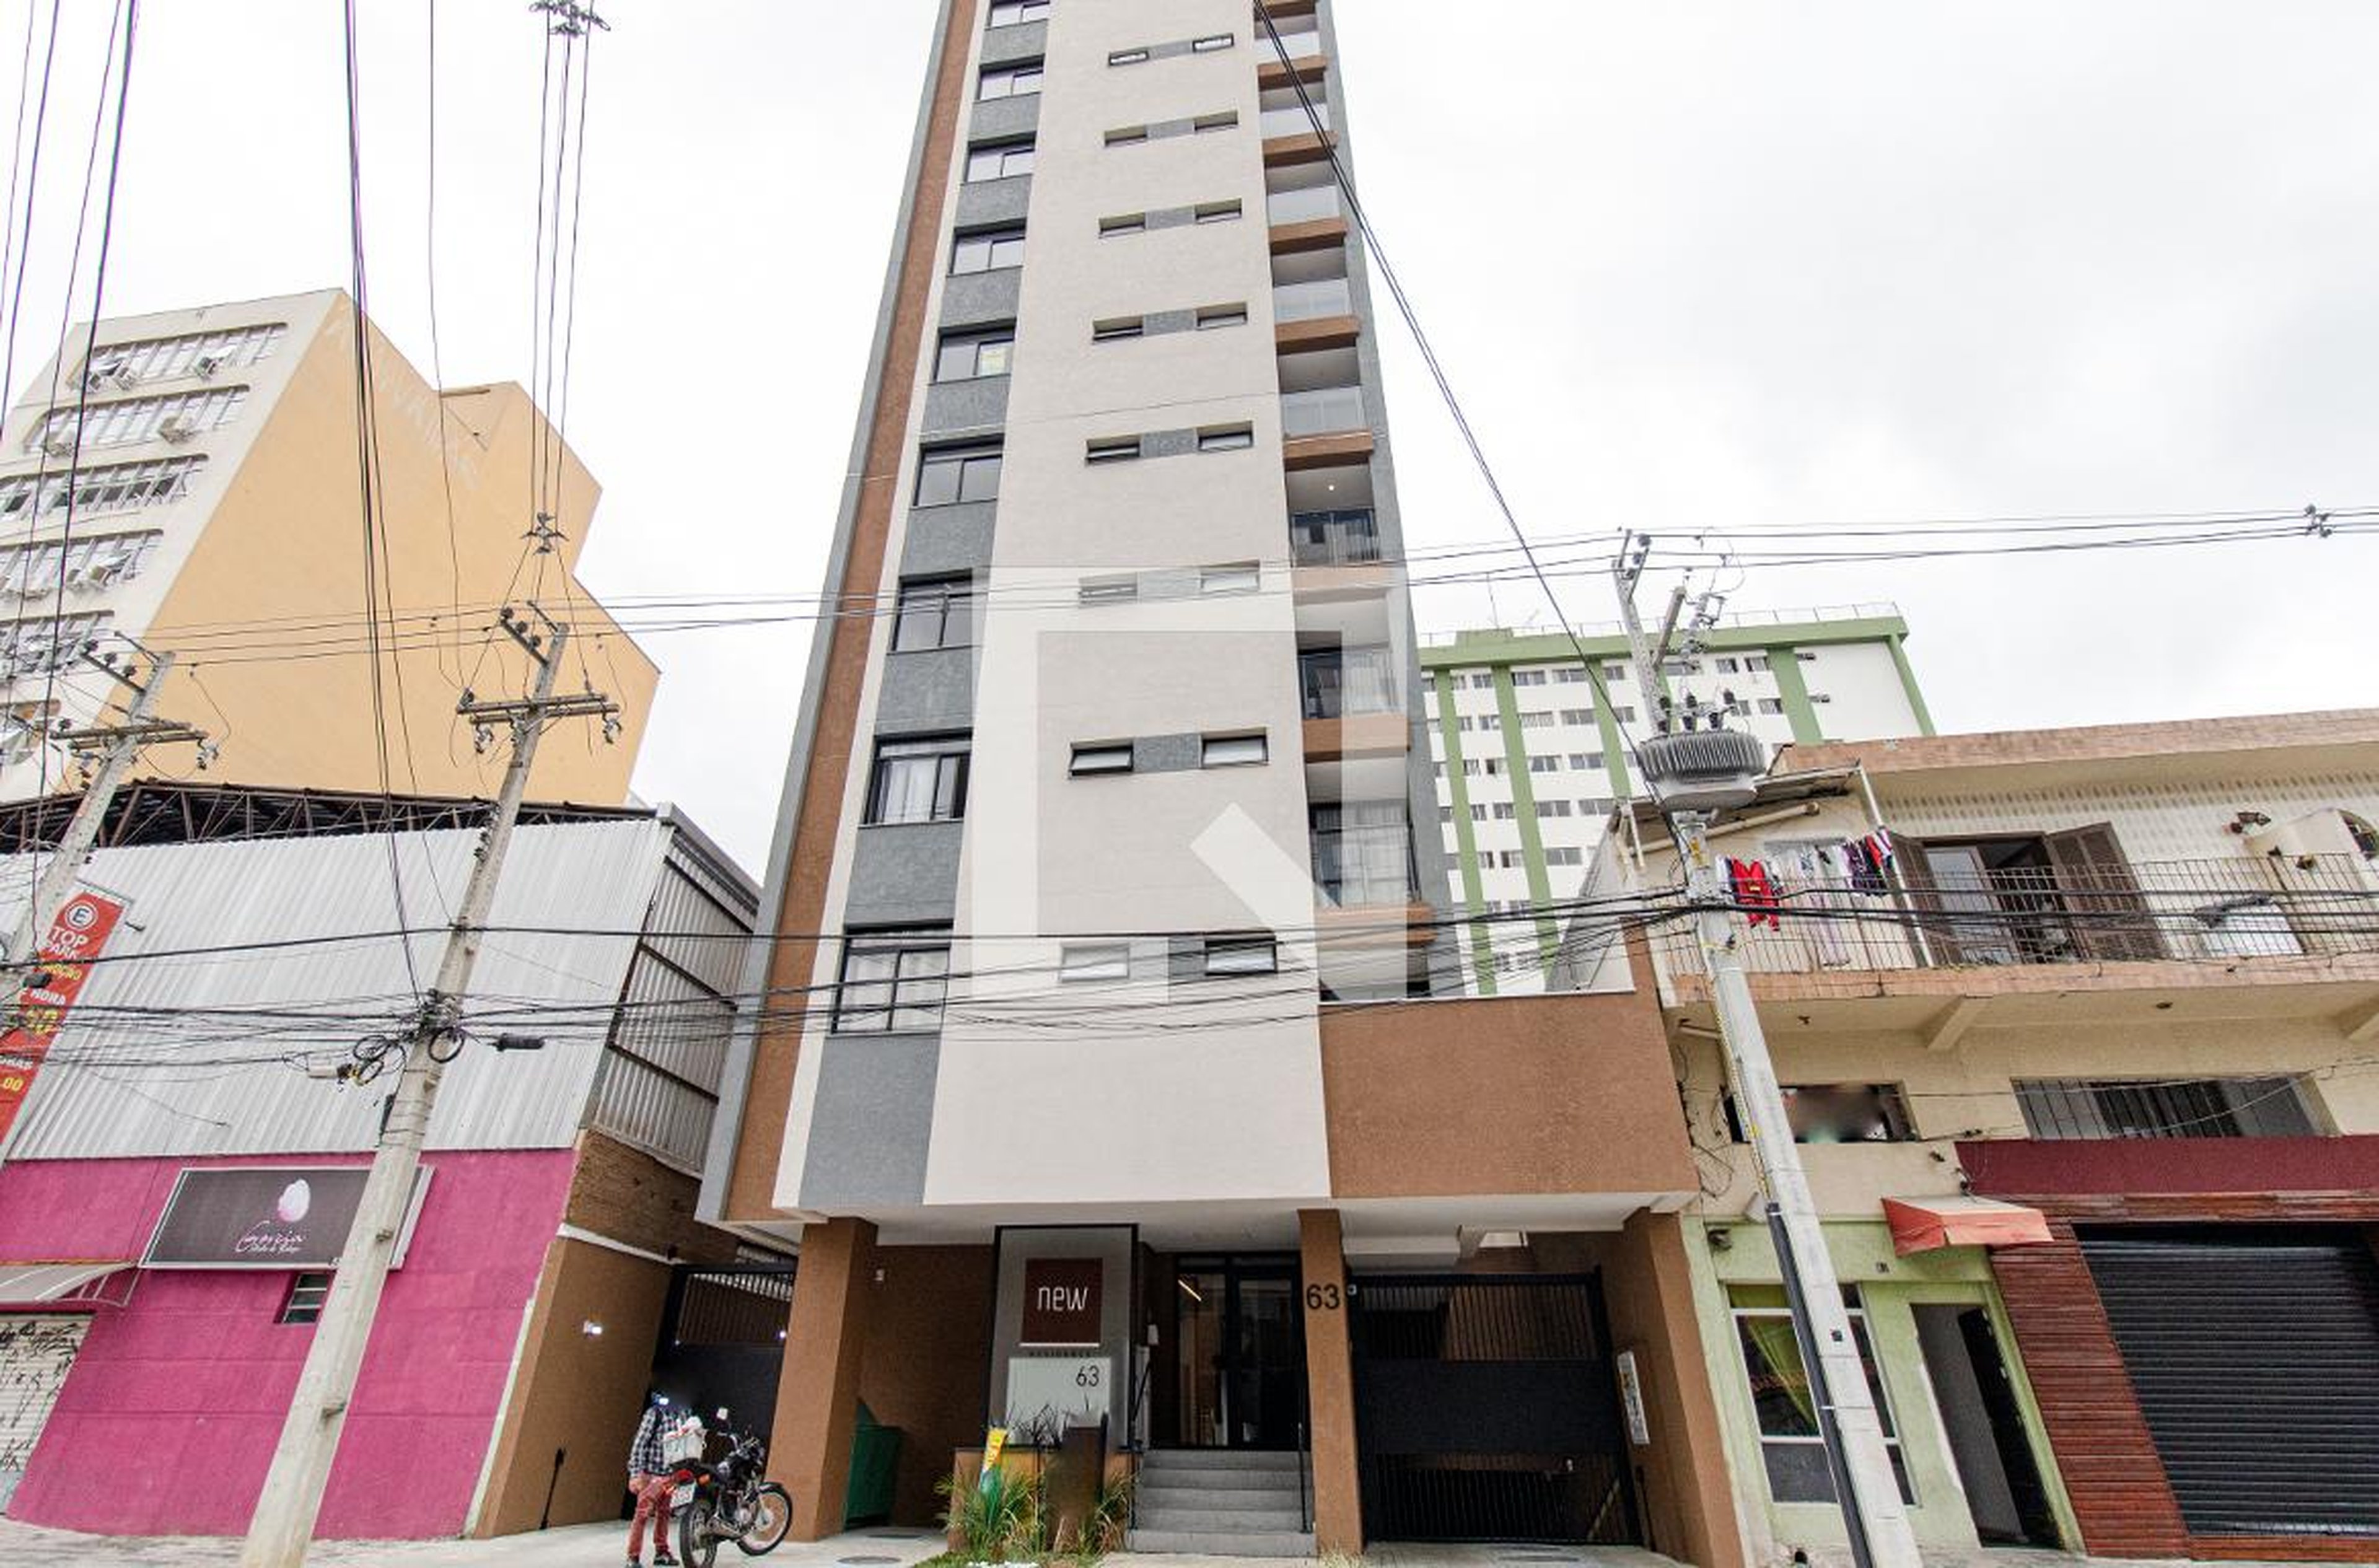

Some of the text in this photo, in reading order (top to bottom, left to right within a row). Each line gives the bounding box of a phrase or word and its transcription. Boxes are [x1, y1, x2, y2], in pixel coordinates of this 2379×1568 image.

[53, 926, 89, 947] TOP
[1037, 1286, 1089, 1311] new
[1307, 1283, 1340, 1310] 63
[1076, 1365, 1100, 1386] 63
